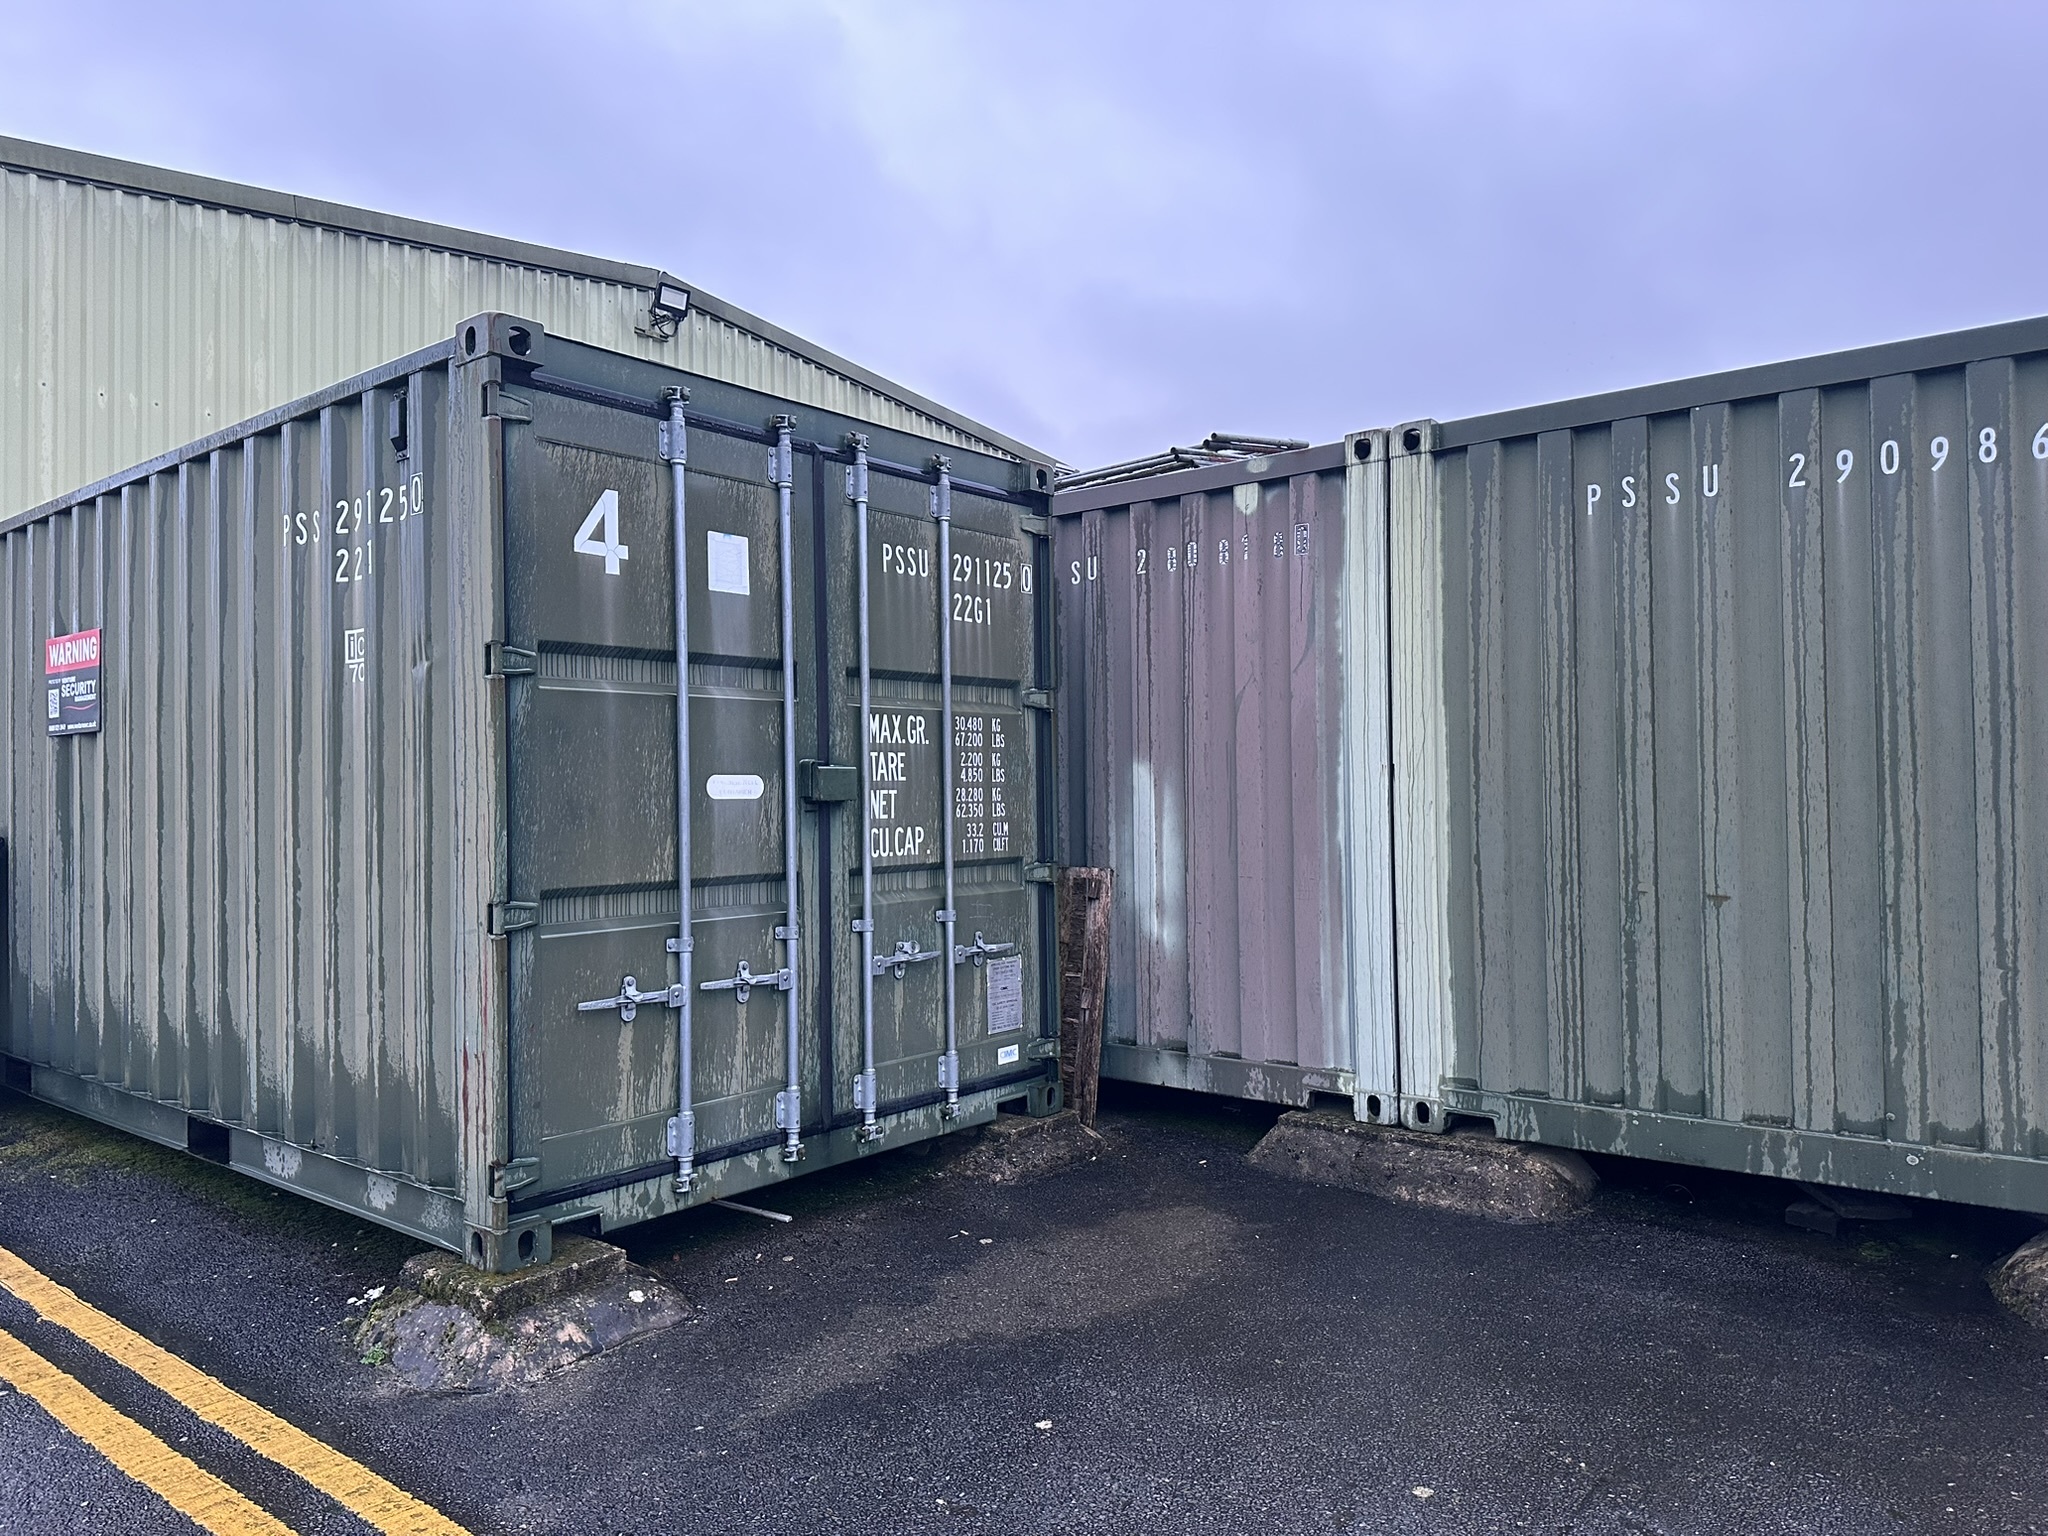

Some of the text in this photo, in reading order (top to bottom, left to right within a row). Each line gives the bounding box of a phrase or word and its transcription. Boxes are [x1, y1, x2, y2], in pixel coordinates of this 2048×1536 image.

[1587, 423, 2048, 515] PSSU 290986
[574, 489, 628, 575] 4
[883, 543, 929, 577] PSSU
[953, 553, 1012, 589] 291125
[953, 593, 991, 625] 22G1
[49, 636, 97, 667] WARNING
[61, 679, 96, 698] SECURITY
[955, 716, 983, 731] 30.480
[991, 718, 1001, 732] KG
[955, 732, 1005, 748] 67.200 LBS
[870, 752, 1001, 781] TARE 2.200 KG
[960, 768, 1006, 783] 4.850 LBS
[870, 788, 1002, 820] NET 28.280 KG
[955, 803, 1006, 817] 62.350 LBS
[966, 823, 984, 837] 33.2
[962, 838, 984, 853] 1.170
